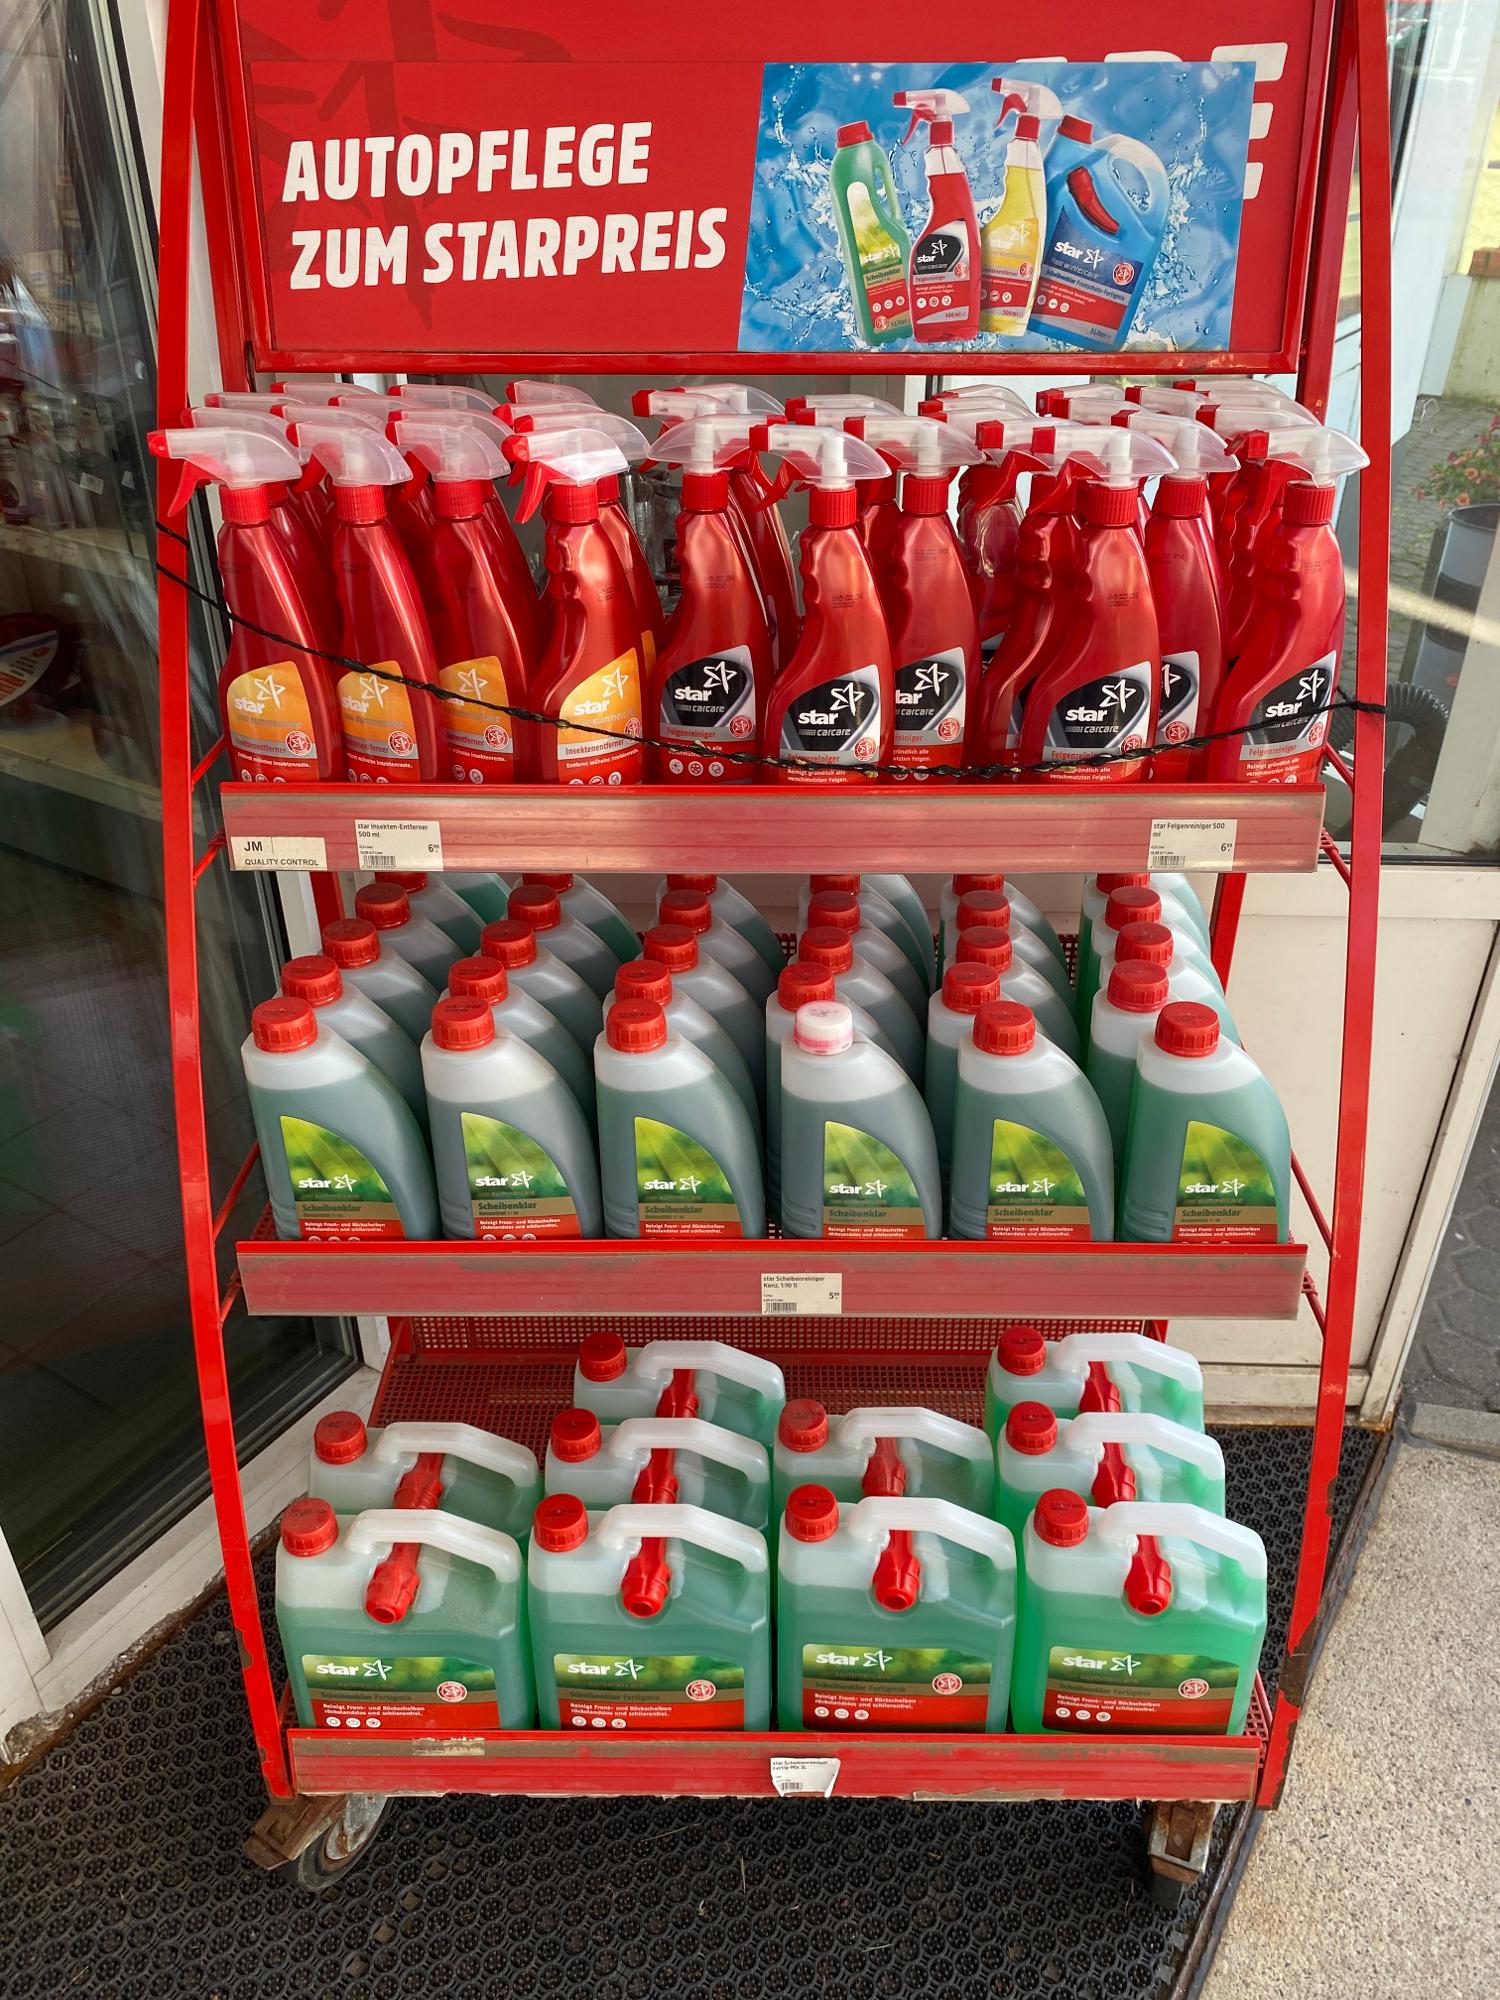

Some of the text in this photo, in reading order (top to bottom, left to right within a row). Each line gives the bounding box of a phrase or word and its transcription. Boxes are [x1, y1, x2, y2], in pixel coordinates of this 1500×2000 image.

[282, 121, 653, 203] AUTOPFLEGE
[289, 207, 728, 290] ZUM STARPREIS
[1054, 241, 1083, 259] star
[917, 255, 936, 263] star
[675, 686, 712, 701] star
[895, 689, 923, 705] tar
[234, 697, 265, 714] star
[342, 696, 369, 713] star
[574, 699, 609, 716] star
[692, 705, 725, 713] carcare
[1265, 701, 1302, 718] star
[798, 710, 839, 725] star
[901, 708, 935, 716] carcare
[1065, 706, 1108, 722] star
[667, 728, 716, 739] Felgenreiniger
[817, 728, 851, 737] carcare
[1084, 725, 1119, 734] carcare
[566, 739, 624, 755] Insektenentferner
[371, 823, 428, 831] Insekten-Entferner
[244, 841, 262, 851] JM
[299, 1178, 331, 1188] star
[475, 1176, 508, 1186] star
[644, 1179, 676, 1190] star
[996, 1182, 1029, 1192] star
[829, 1184, 862, 1194] star
[1185, 1183, 1219, 1193] star
[994, 1208, 1054, 1216] Scheibenklar
[816, 1652, 859, 1666] star
[1062, 1656, 1106, 1669] star
[316, 1663, 358, 1676] star
[568, 1662, 610, 1675] star
